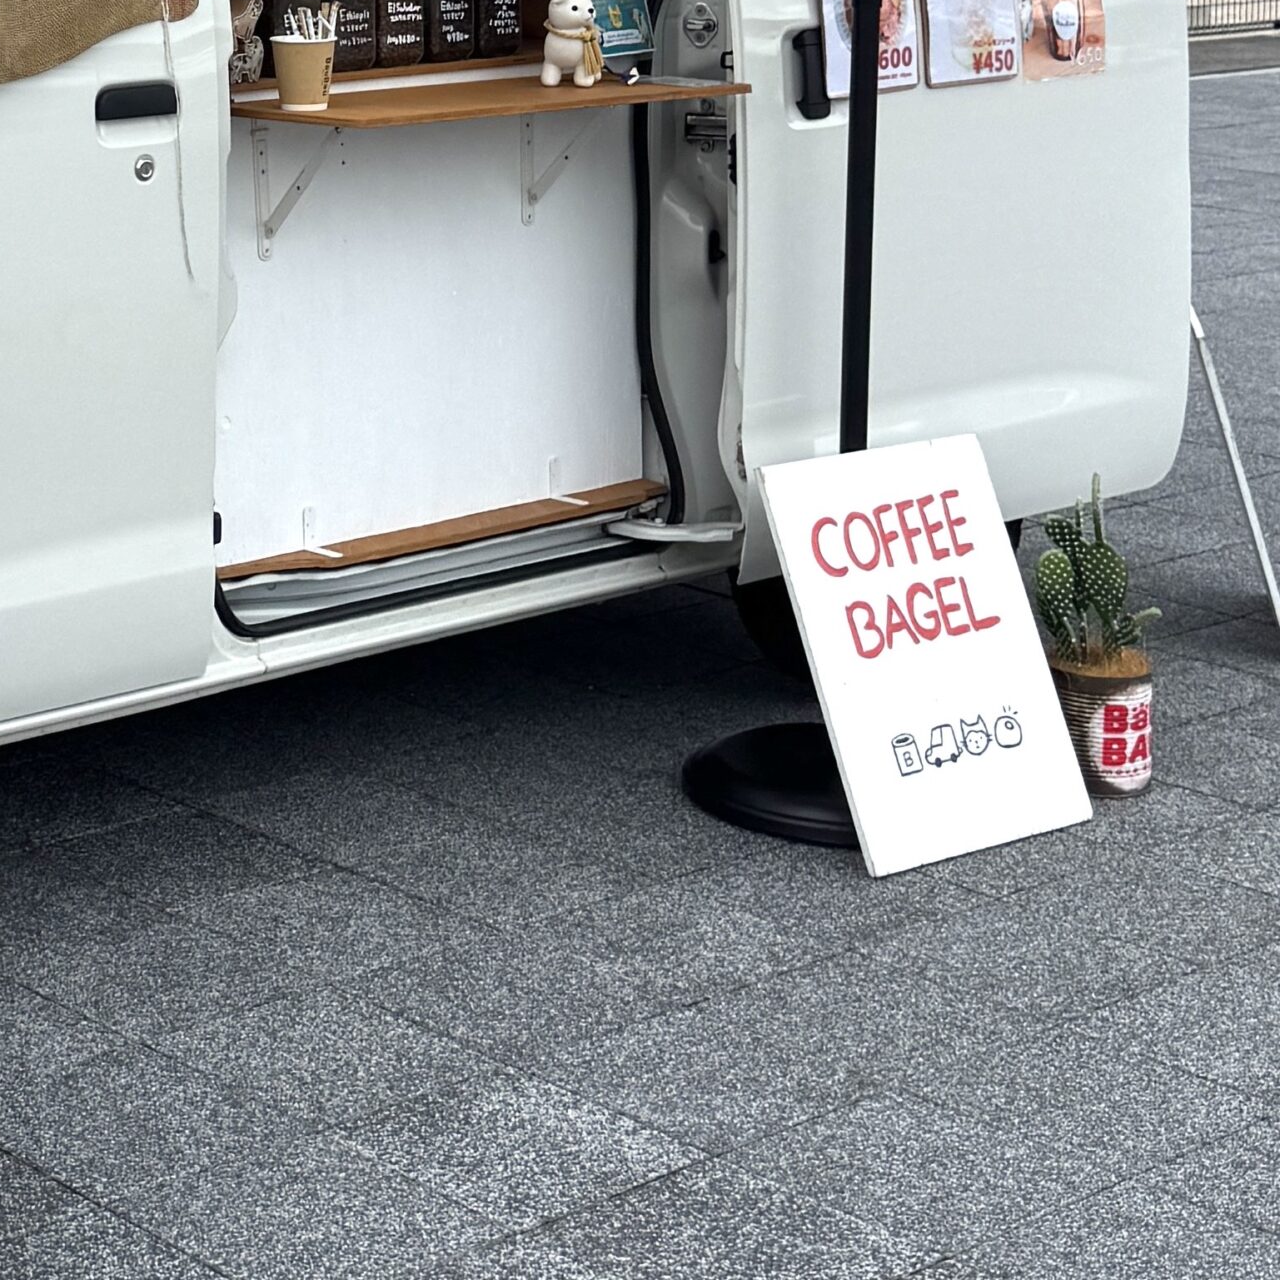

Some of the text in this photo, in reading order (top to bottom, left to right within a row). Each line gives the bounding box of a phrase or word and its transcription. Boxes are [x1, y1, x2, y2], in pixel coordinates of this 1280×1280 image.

[972, 48, 1015, 75] ¥450
[811, 489, 974, 578] COFFEE
[845, 576, 1001, 659] BAGEL
